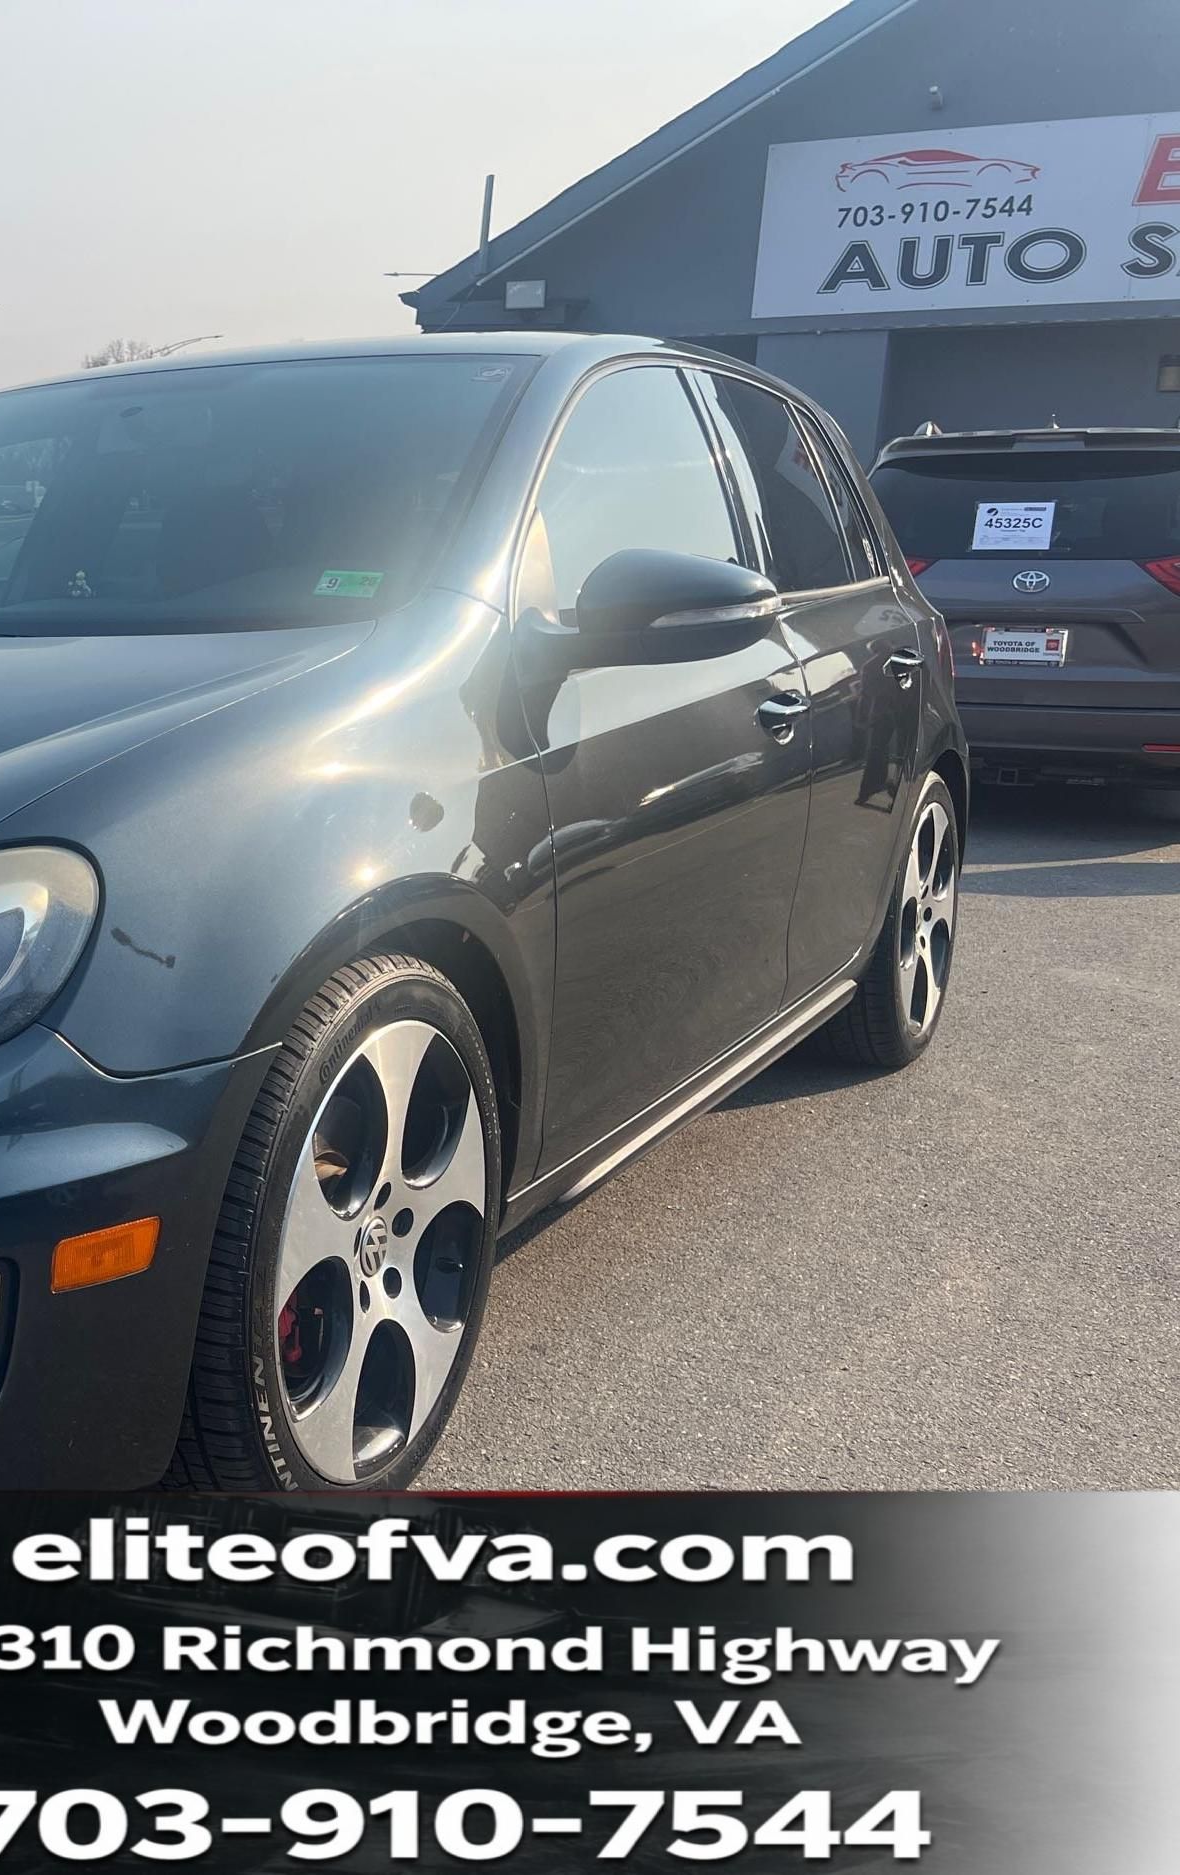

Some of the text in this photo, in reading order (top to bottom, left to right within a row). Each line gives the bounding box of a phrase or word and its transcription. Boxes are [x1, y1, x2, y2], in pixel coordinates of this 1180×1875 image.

[837, 194, 1034, 228] 703-910-7544
[817, 221, 1180, 295] AUTO S
[984, 517, 1043, 529] 45325C
